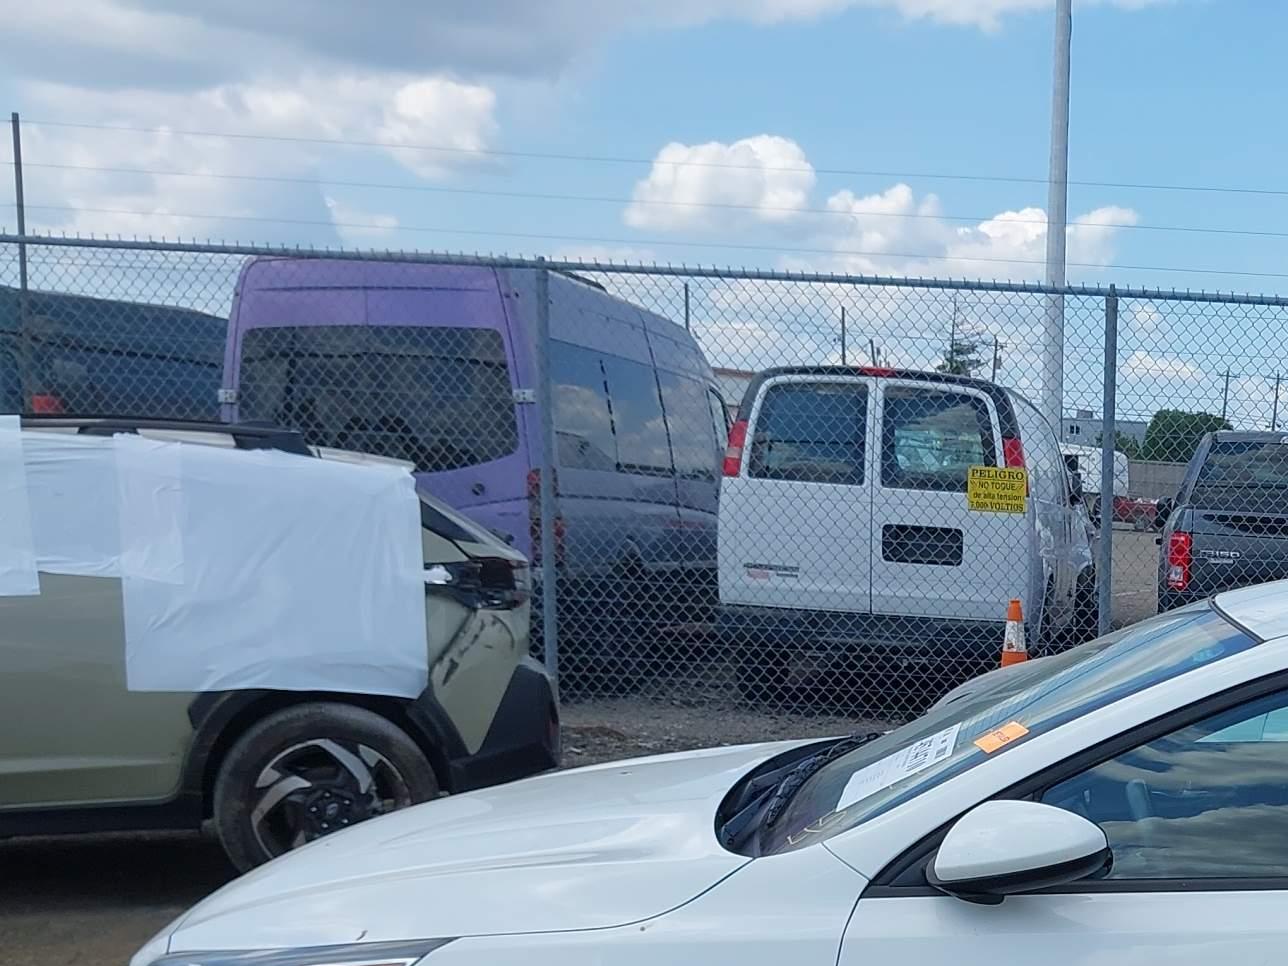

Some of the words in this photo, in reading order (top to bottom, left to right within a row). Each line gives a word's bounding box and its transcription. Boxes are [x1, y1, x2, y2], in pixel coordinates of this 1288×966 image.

[971, 469, 1024, 481] PELIGRO
[978, 481, 989, 490] NO
[991, 482, 1015, 491] TOQUE
